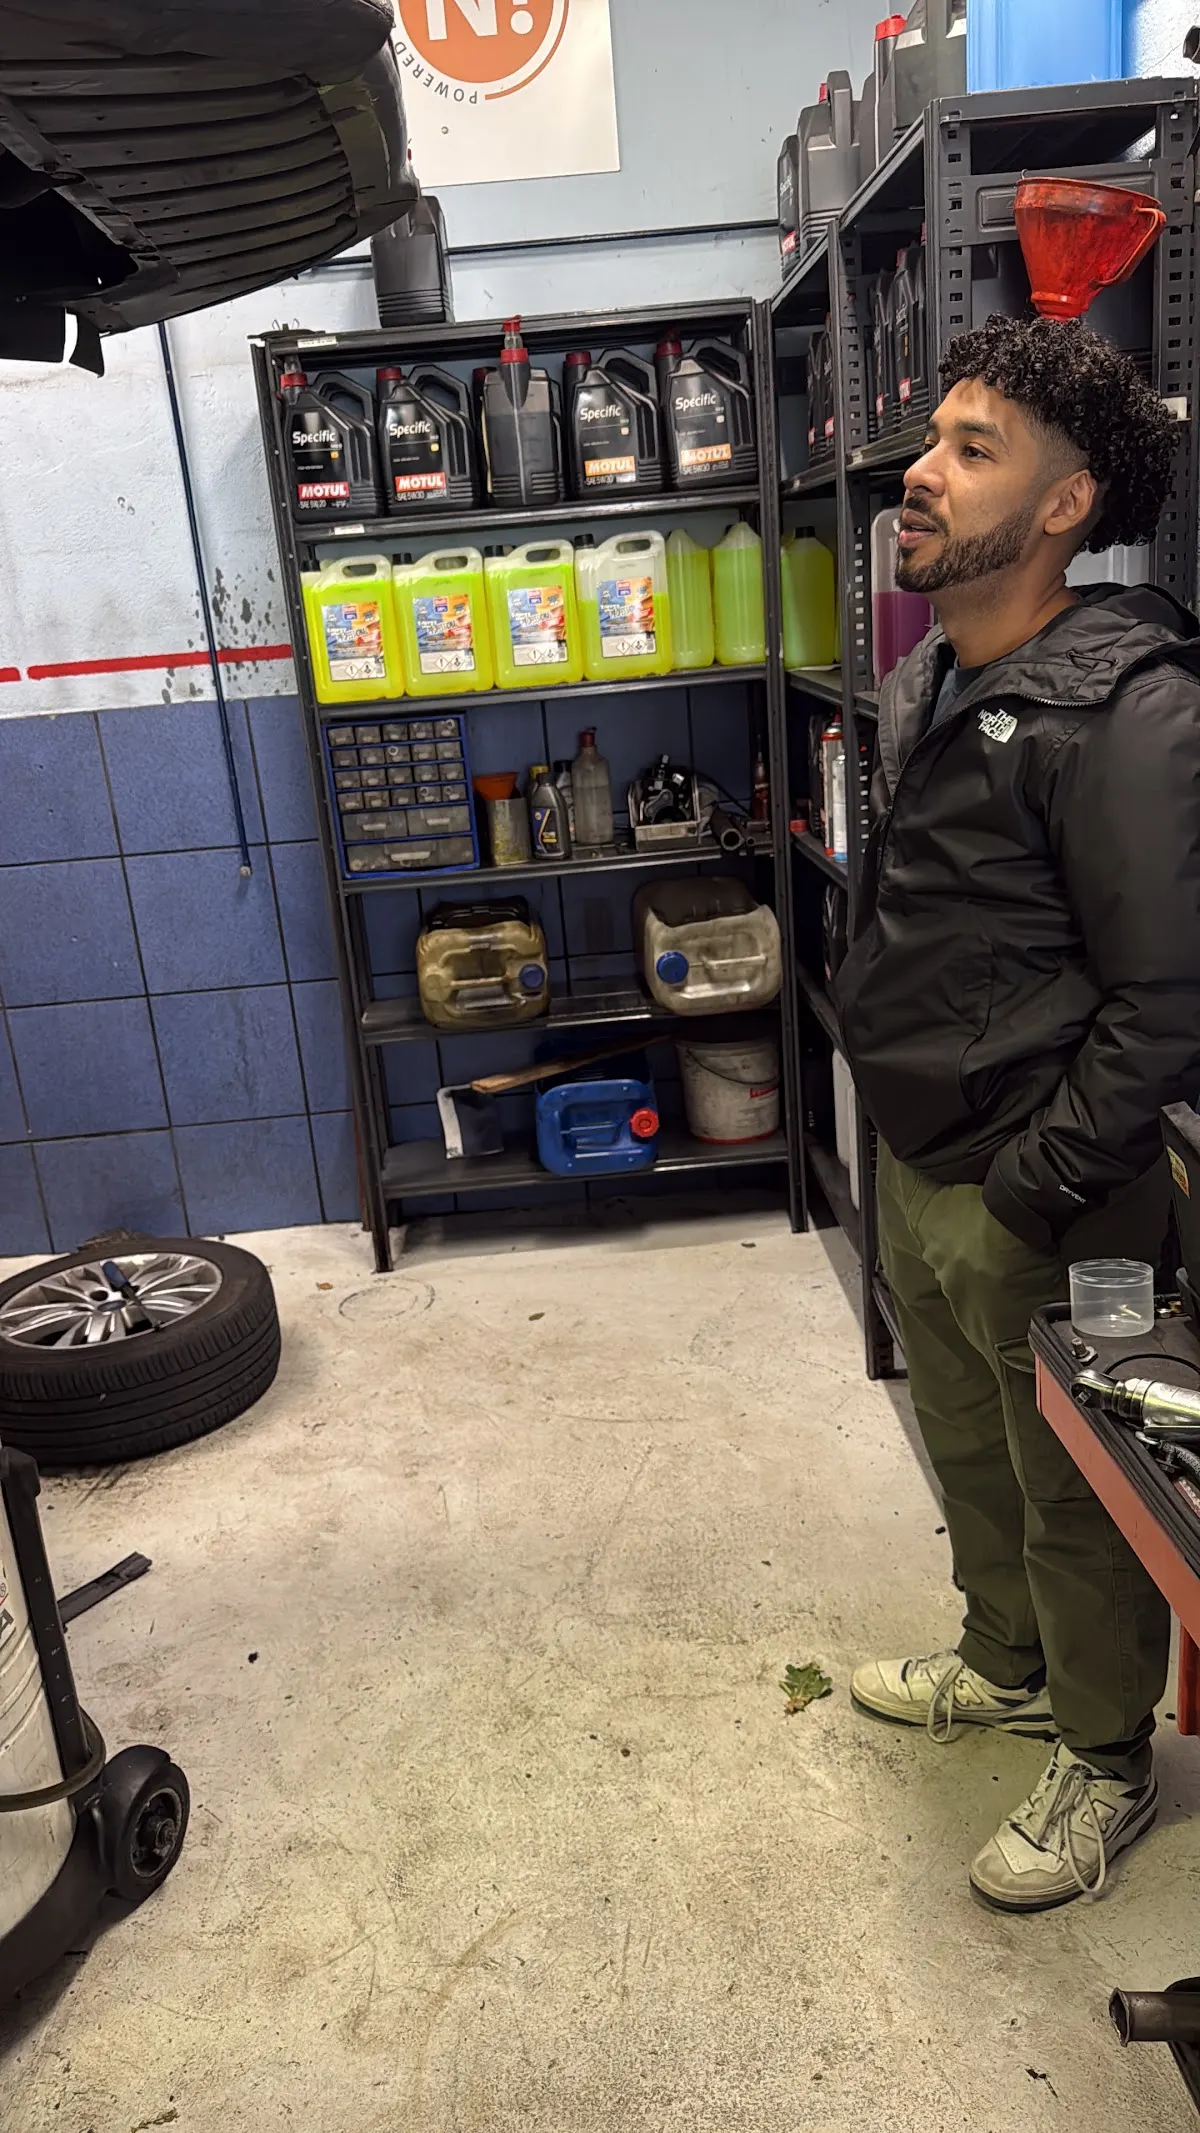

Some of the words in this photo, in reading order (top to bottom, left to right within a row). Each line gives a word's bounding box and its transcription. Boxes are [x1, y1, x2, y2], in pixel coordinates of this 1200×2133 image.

[394, 41, 478, 104] POWERED
[675, 392, 717, 412] Specific
[580, 404, 621, 423] Specific
[292, 429, 336, 447] Specific
[389, 420, 431, 439] Specific
[588, 459, 632, 474] MOTUL
[301, 483, 347, 498] MOTUL
[398, 474, 444, 489] MOTUL
[977, 708, 1009, 732] NORTH
[995, 708, 1015, 727] THE
[977, 720, 1002, 741] FACE
[1058, 1184, 1087, 1204] DRYVENT
